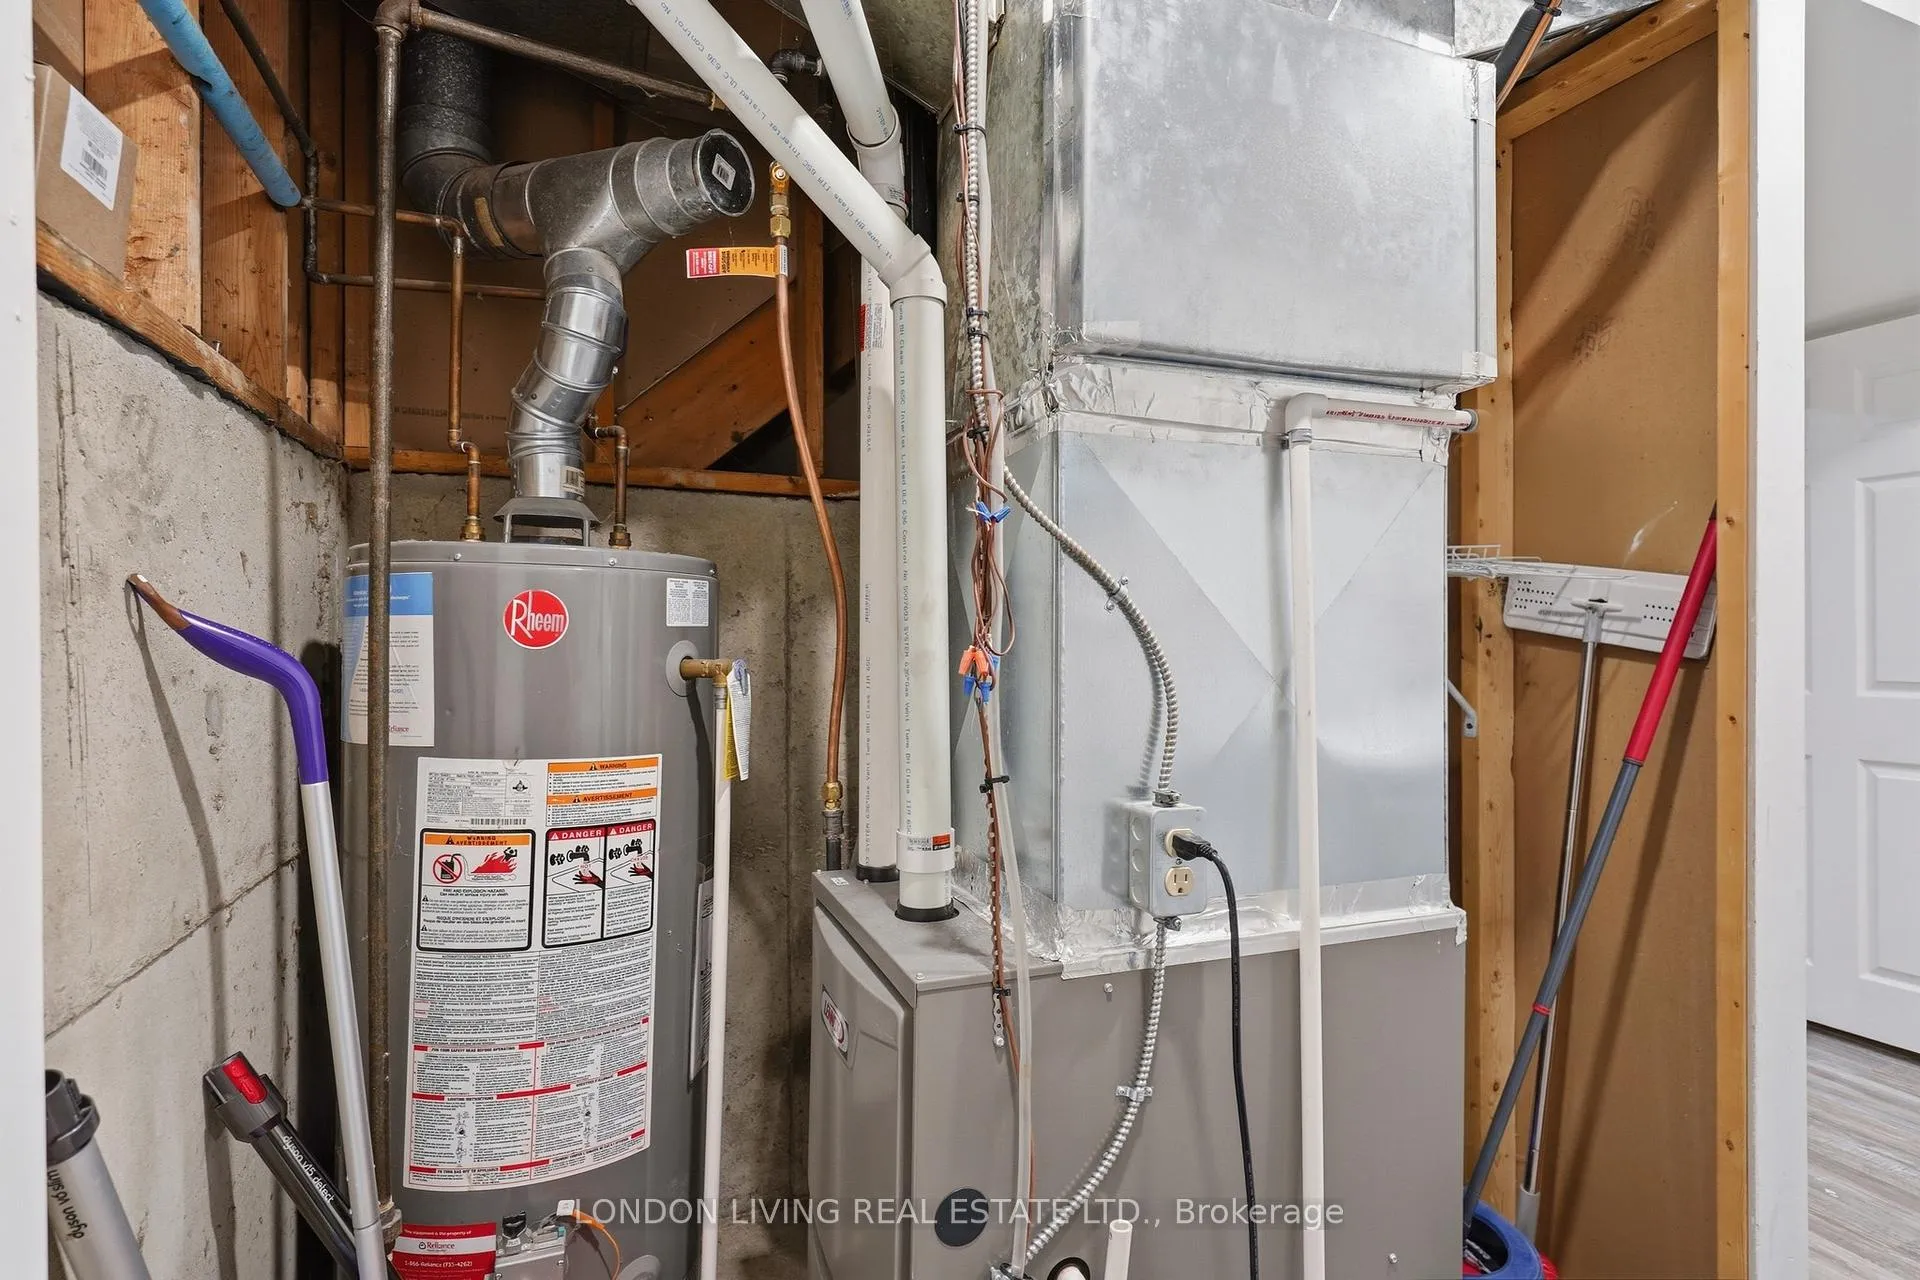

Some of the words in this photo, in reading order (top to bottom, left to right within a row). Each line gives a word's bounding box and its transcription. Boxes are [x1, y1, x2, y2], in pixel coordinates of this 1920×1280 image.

[658, 1, 672, 14] No
[670, 15, 707, 52] Control
[704, 52, 722, 70] 636
[721, 71, 738, 88] ULC
[737, 89, 767, 120] Listed
[510, 590, 565, 639] Rheem
[583, 793, 632, 802] AVERTISSEMENT
[562, 830, 602, 839] DANGER
[620, 824, 652, 833] DANGER
[282, 1135, 304, 1164] dyson
[302, 1160, 316, 1178] v15
[312, 1176, 335, 1204] detect
[47, 1169, 64, 1192] slim
[66, 1206, 88, 1239] dyson
